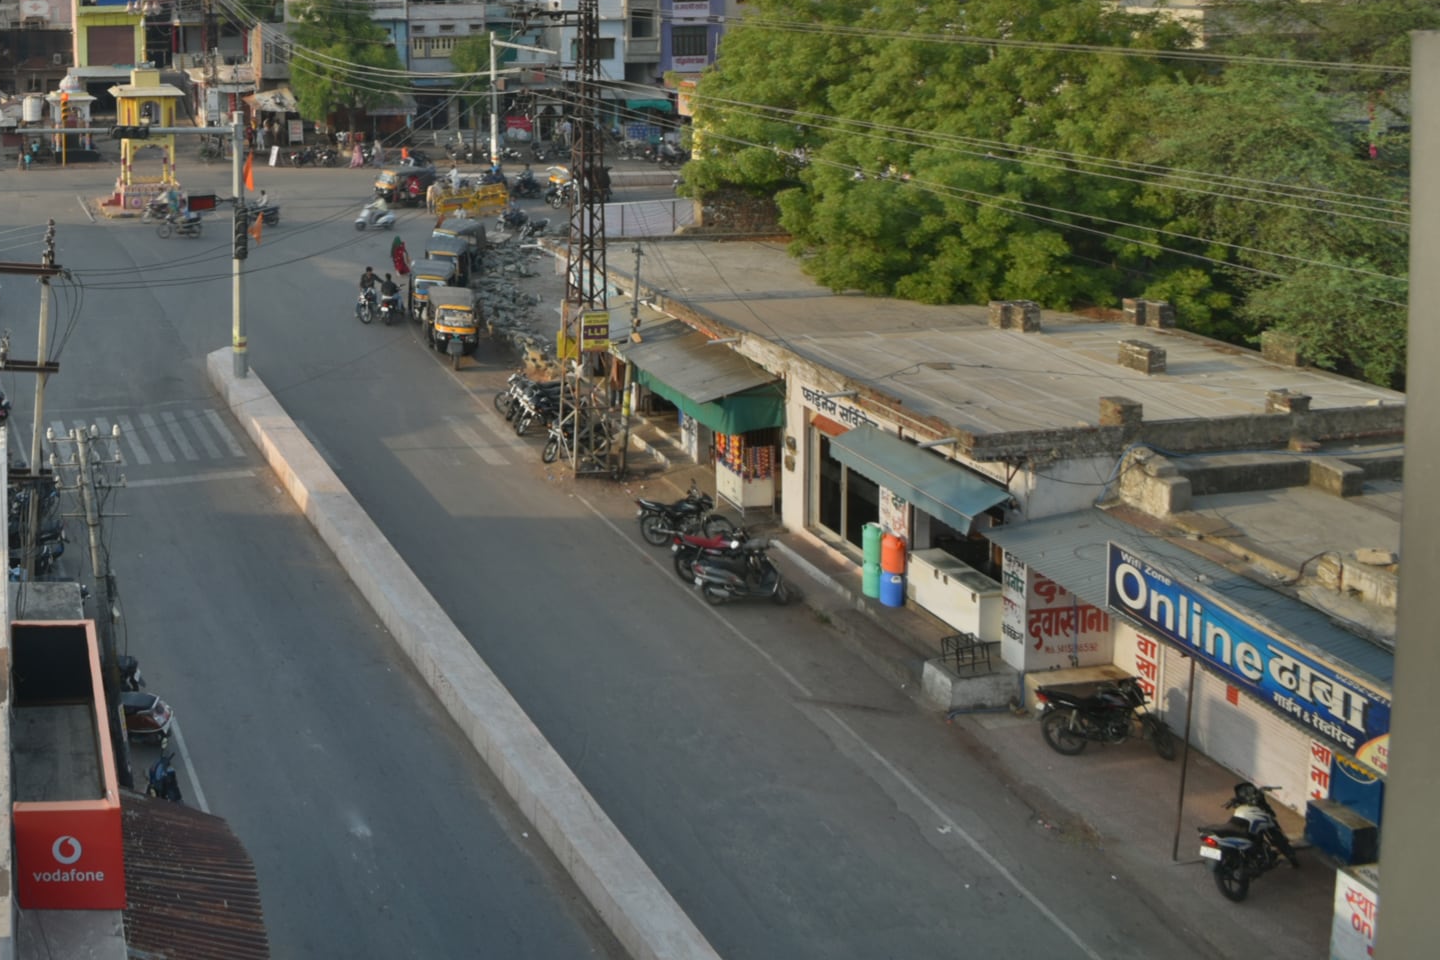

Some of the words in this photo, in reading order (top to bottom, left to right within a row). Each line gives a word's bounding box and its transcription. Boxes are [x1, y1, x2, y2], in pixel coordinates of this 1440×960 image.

[1120, 550, 1142, 570] Wifi
[1144, 565, 1172, 586] Zone
[1114, 562, 1264, 681] Online
[1266, 643, 1369, 733] ढाबा
[1303, 711, 1311, 724] &
[32, 867, 105, 883] vodafone
